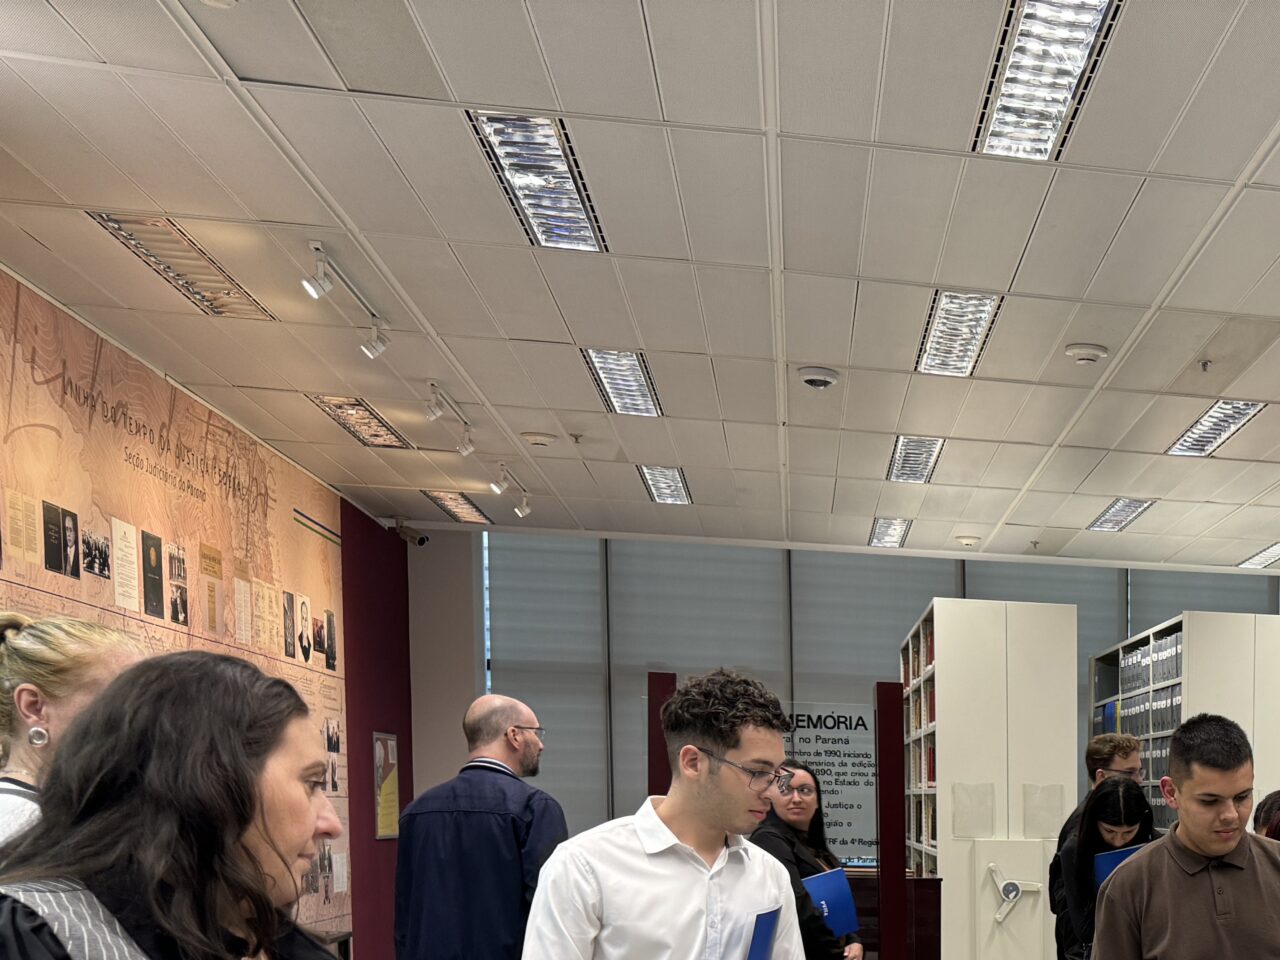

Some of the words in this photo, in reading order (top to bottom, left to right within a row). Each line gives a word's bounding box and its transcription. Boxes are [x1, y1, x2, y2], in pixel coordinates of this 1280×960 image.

[103, 404, 116, 424] DO
[122, 411, 155, 445] TEMPO
[124, 446, 145, 471] Seção
[799, 736, 811, 744] no
[815, 735, 849, 745] Paraná
[813, 749, 822, 757] de
[843, 749, 872, 759] iniciando
[838, 760, 848, 768] da
[835, 778, 860, 787] Estado
[864, 778, 874, 787] do
[825, 801, 854, 810] Justiça
